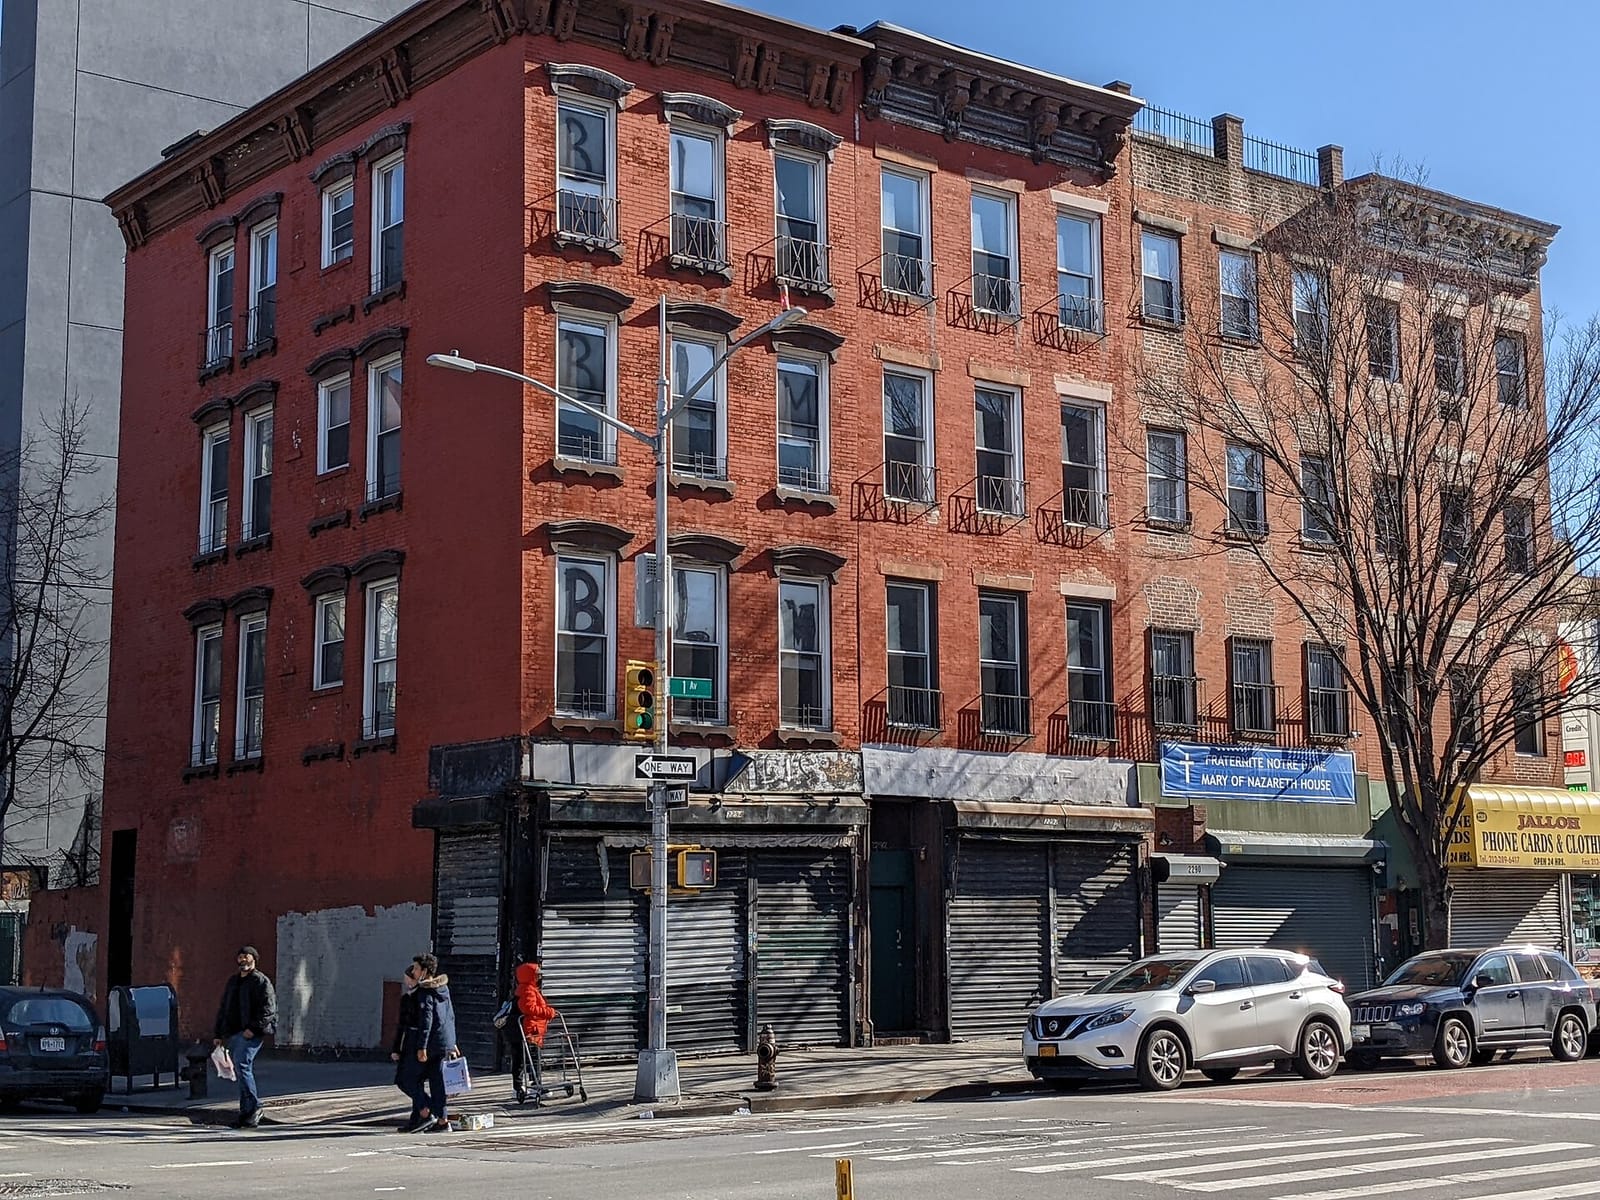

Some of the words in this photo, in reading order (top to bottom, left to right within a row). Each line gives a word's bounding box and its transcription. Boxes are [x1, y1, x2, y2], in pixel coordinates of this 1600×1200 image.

[563, 568, 604, 649] B
[682, 680, 686, 694] 1
[644, 762, 662, 773] ONE
[670, 763, 689, 773] WAY
[1205, 754, 1264, 768] FRATERNITE
[1267, 758, 1298, 770] NOTRE
[1201, 773, 1228, 786] MARY
[1231, 775, 1244, 787] OF
[1248, 776, 1297, 789] NAZARETH
[1300, 779, 1331, 791] HOUSE
[1517, 815, 1581, 830] JALLOH
[1482, 831, 1518, 852] PHONE
[1521, 833, 1553, 854] CARDS
[1556, 834, 1564, 854] &
[1534, 857, 1547, 865] OPEN
